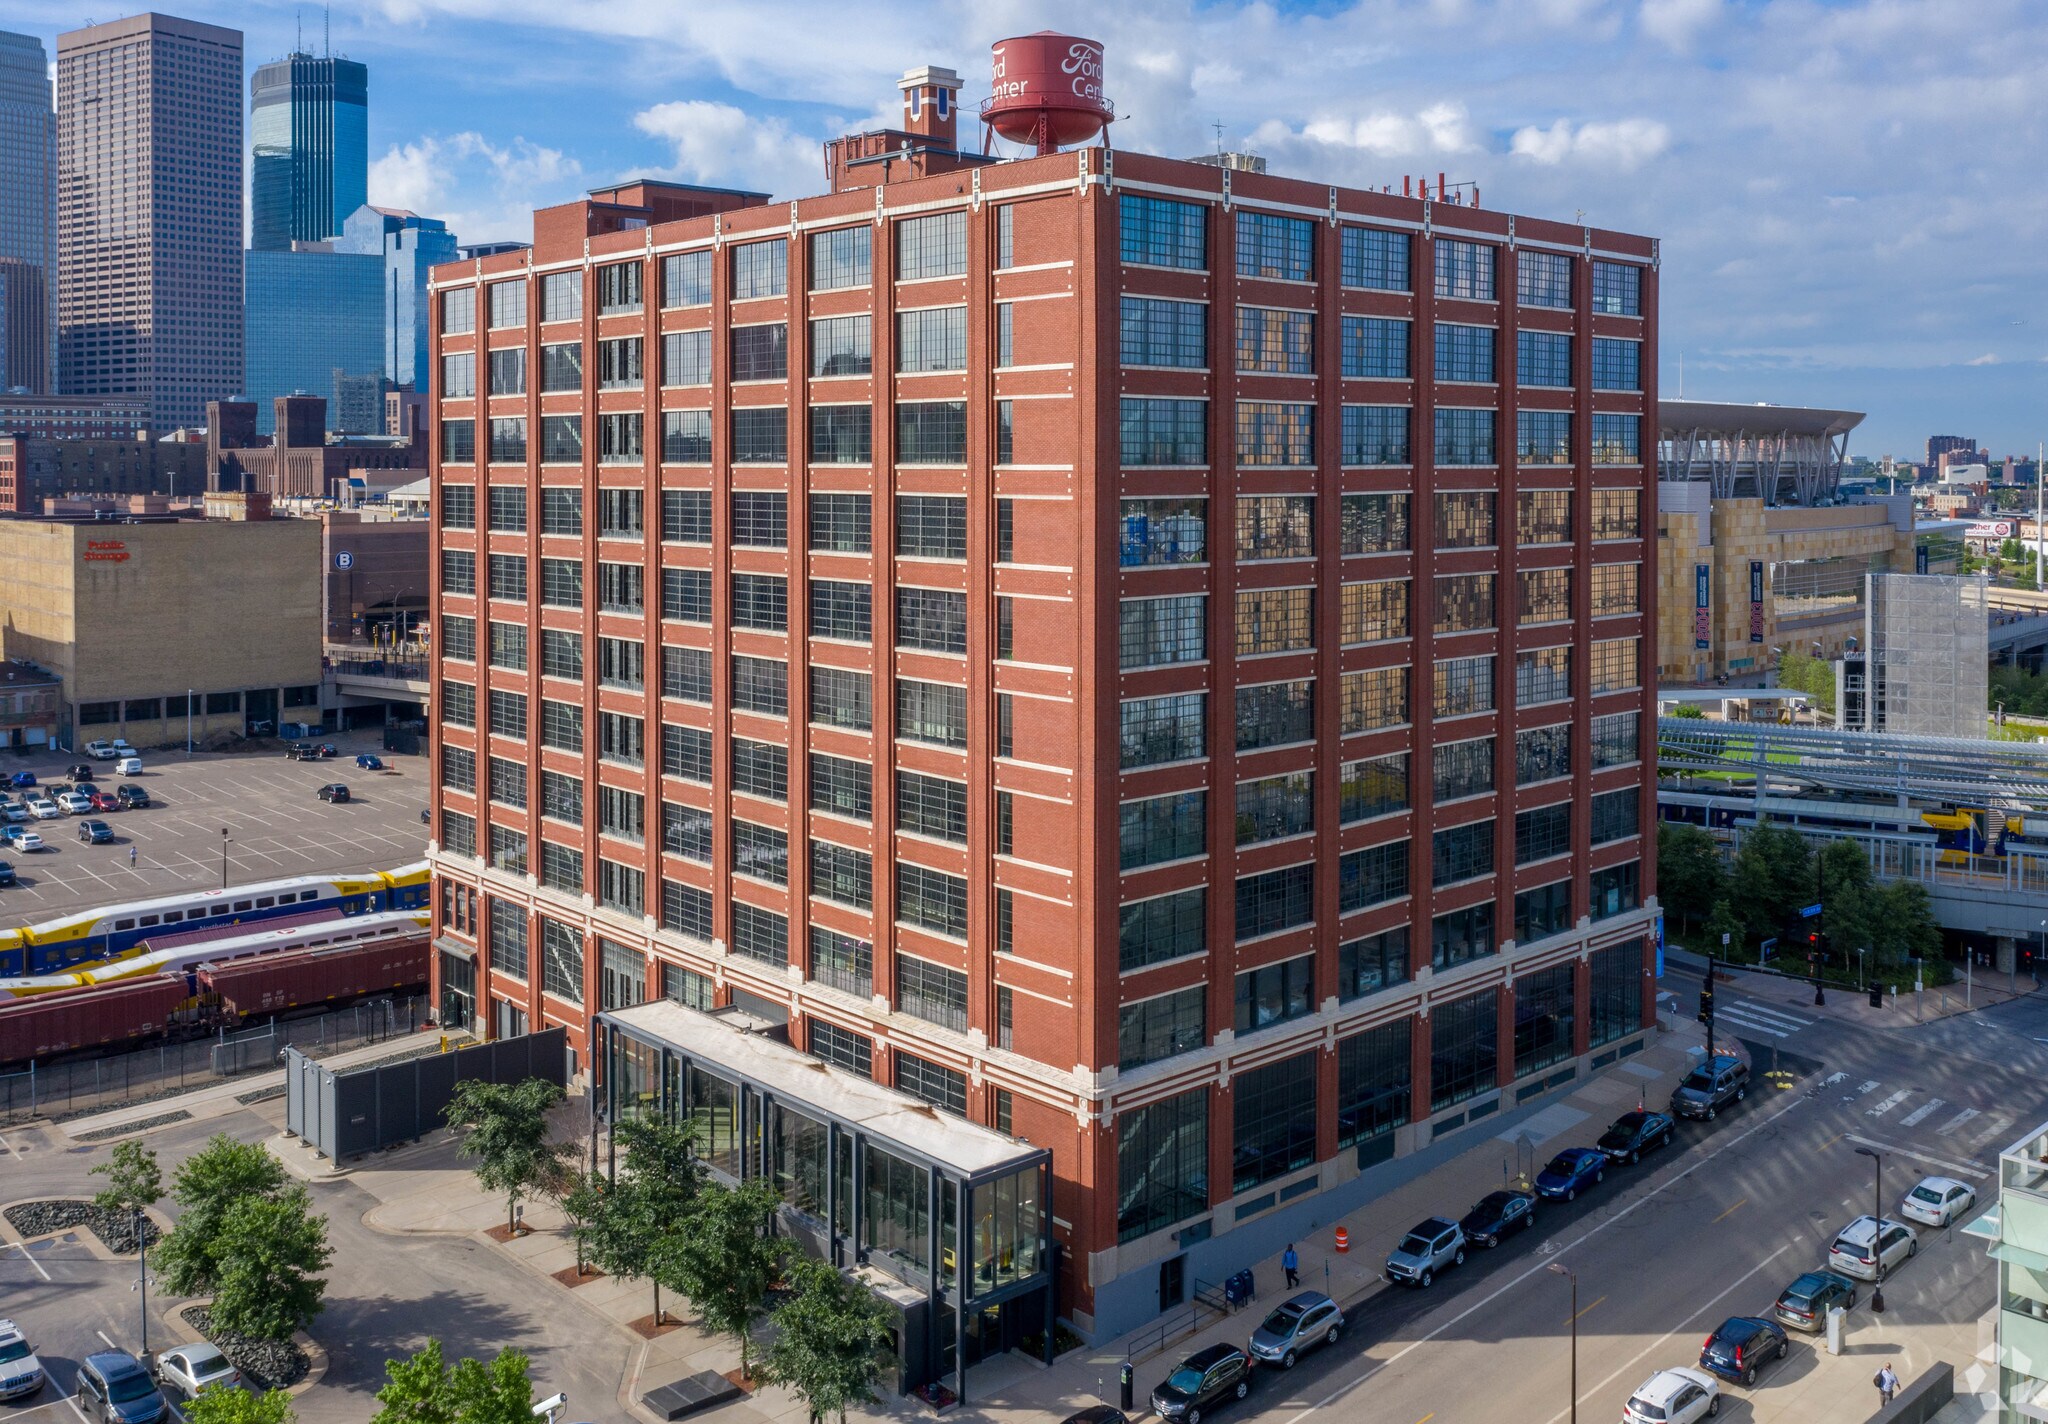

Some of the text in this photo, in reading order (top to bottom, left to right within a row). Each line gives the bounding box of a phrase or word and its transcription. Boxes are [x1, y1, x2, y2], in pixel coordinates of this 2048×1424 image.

[87, 541, 125, 550] Public
[84, 551, 130, 564] Storage
[339, 554, 350, 565] B
[1696, 607, 1709, 640] 2004
